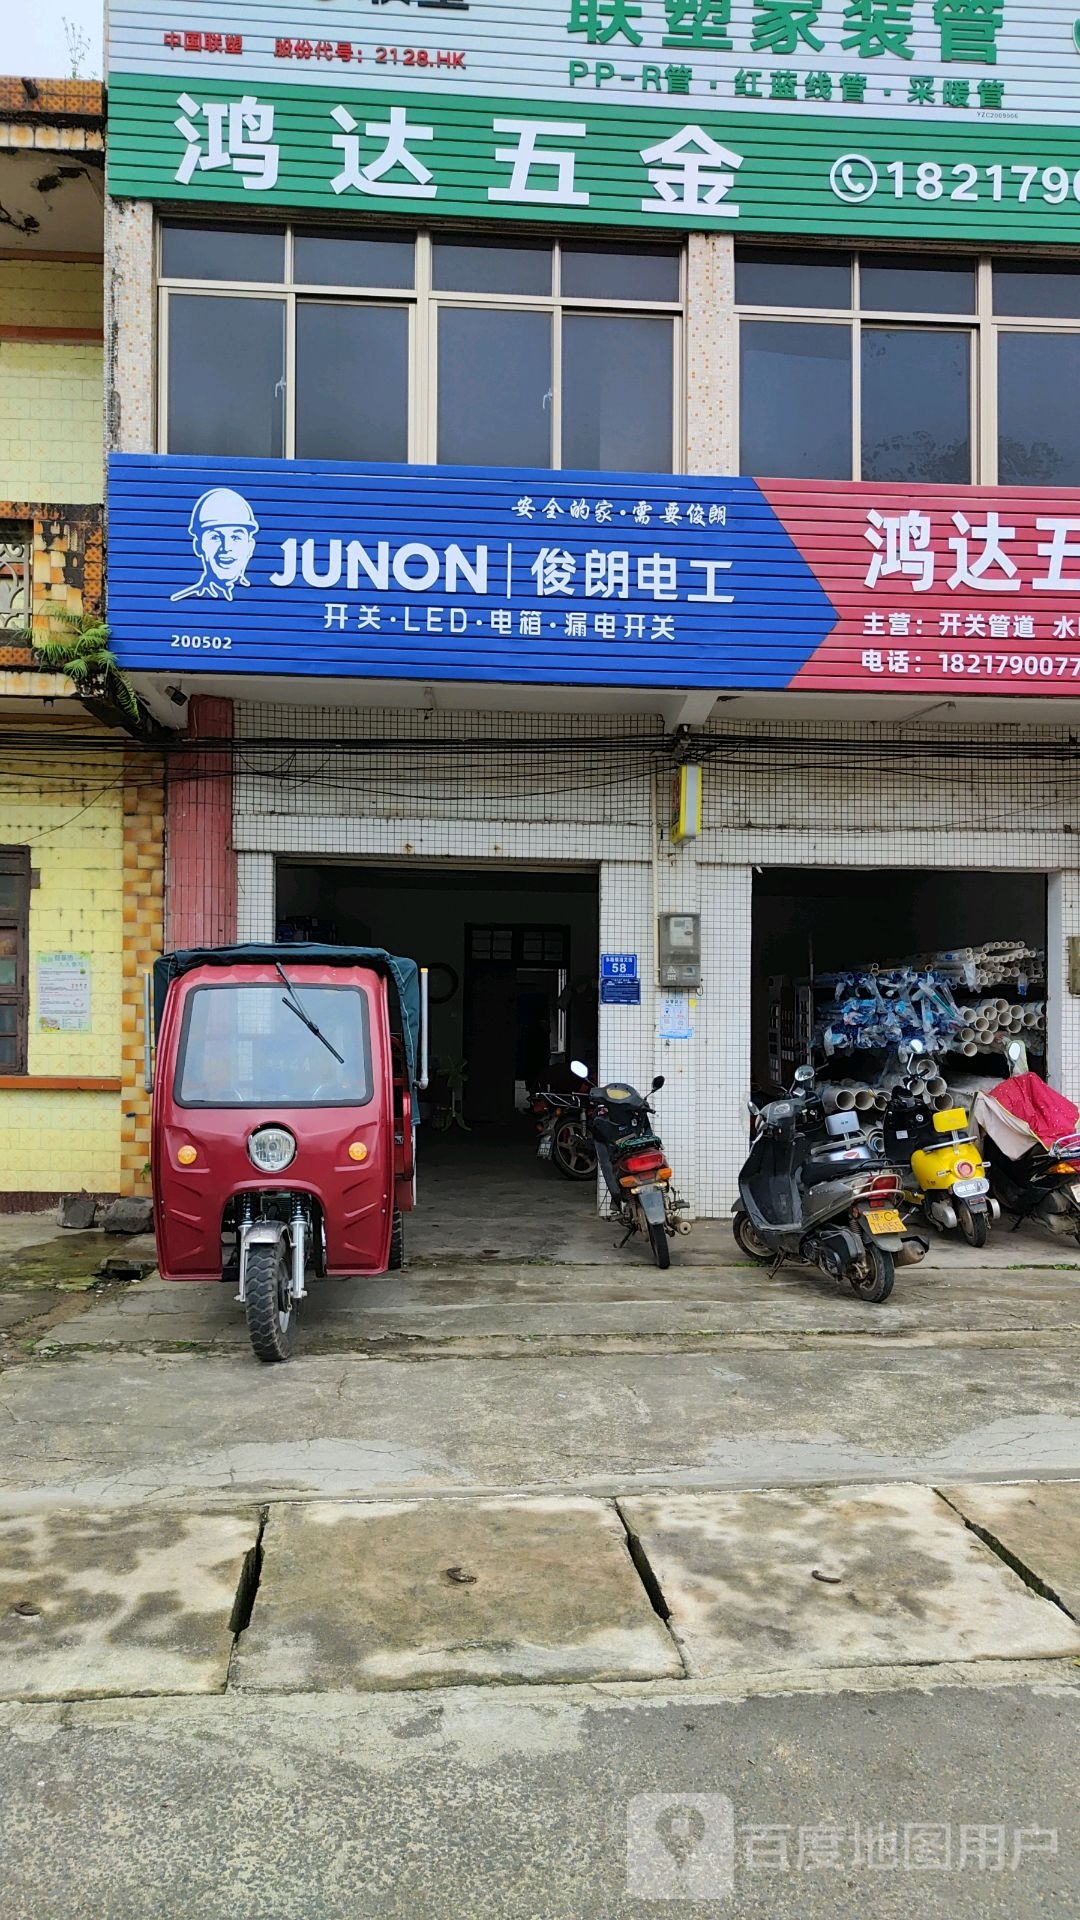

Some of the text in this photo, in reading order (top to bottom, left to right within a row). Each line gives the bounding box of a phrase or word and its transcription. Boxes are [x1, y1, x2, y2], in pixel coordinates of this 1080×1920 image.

[163, 32, 243, 55] 中国联塑
[173, 92, 744, 218] 鸿达五金
[886, 161, 1080, 205] 182179
[269, 538, 735, 604] JUNON 俊朗电工
[1052, 615, 1080, 639] 水
[170, 634, 232, 650] 200502
[611, 962, 627, 973] 58
